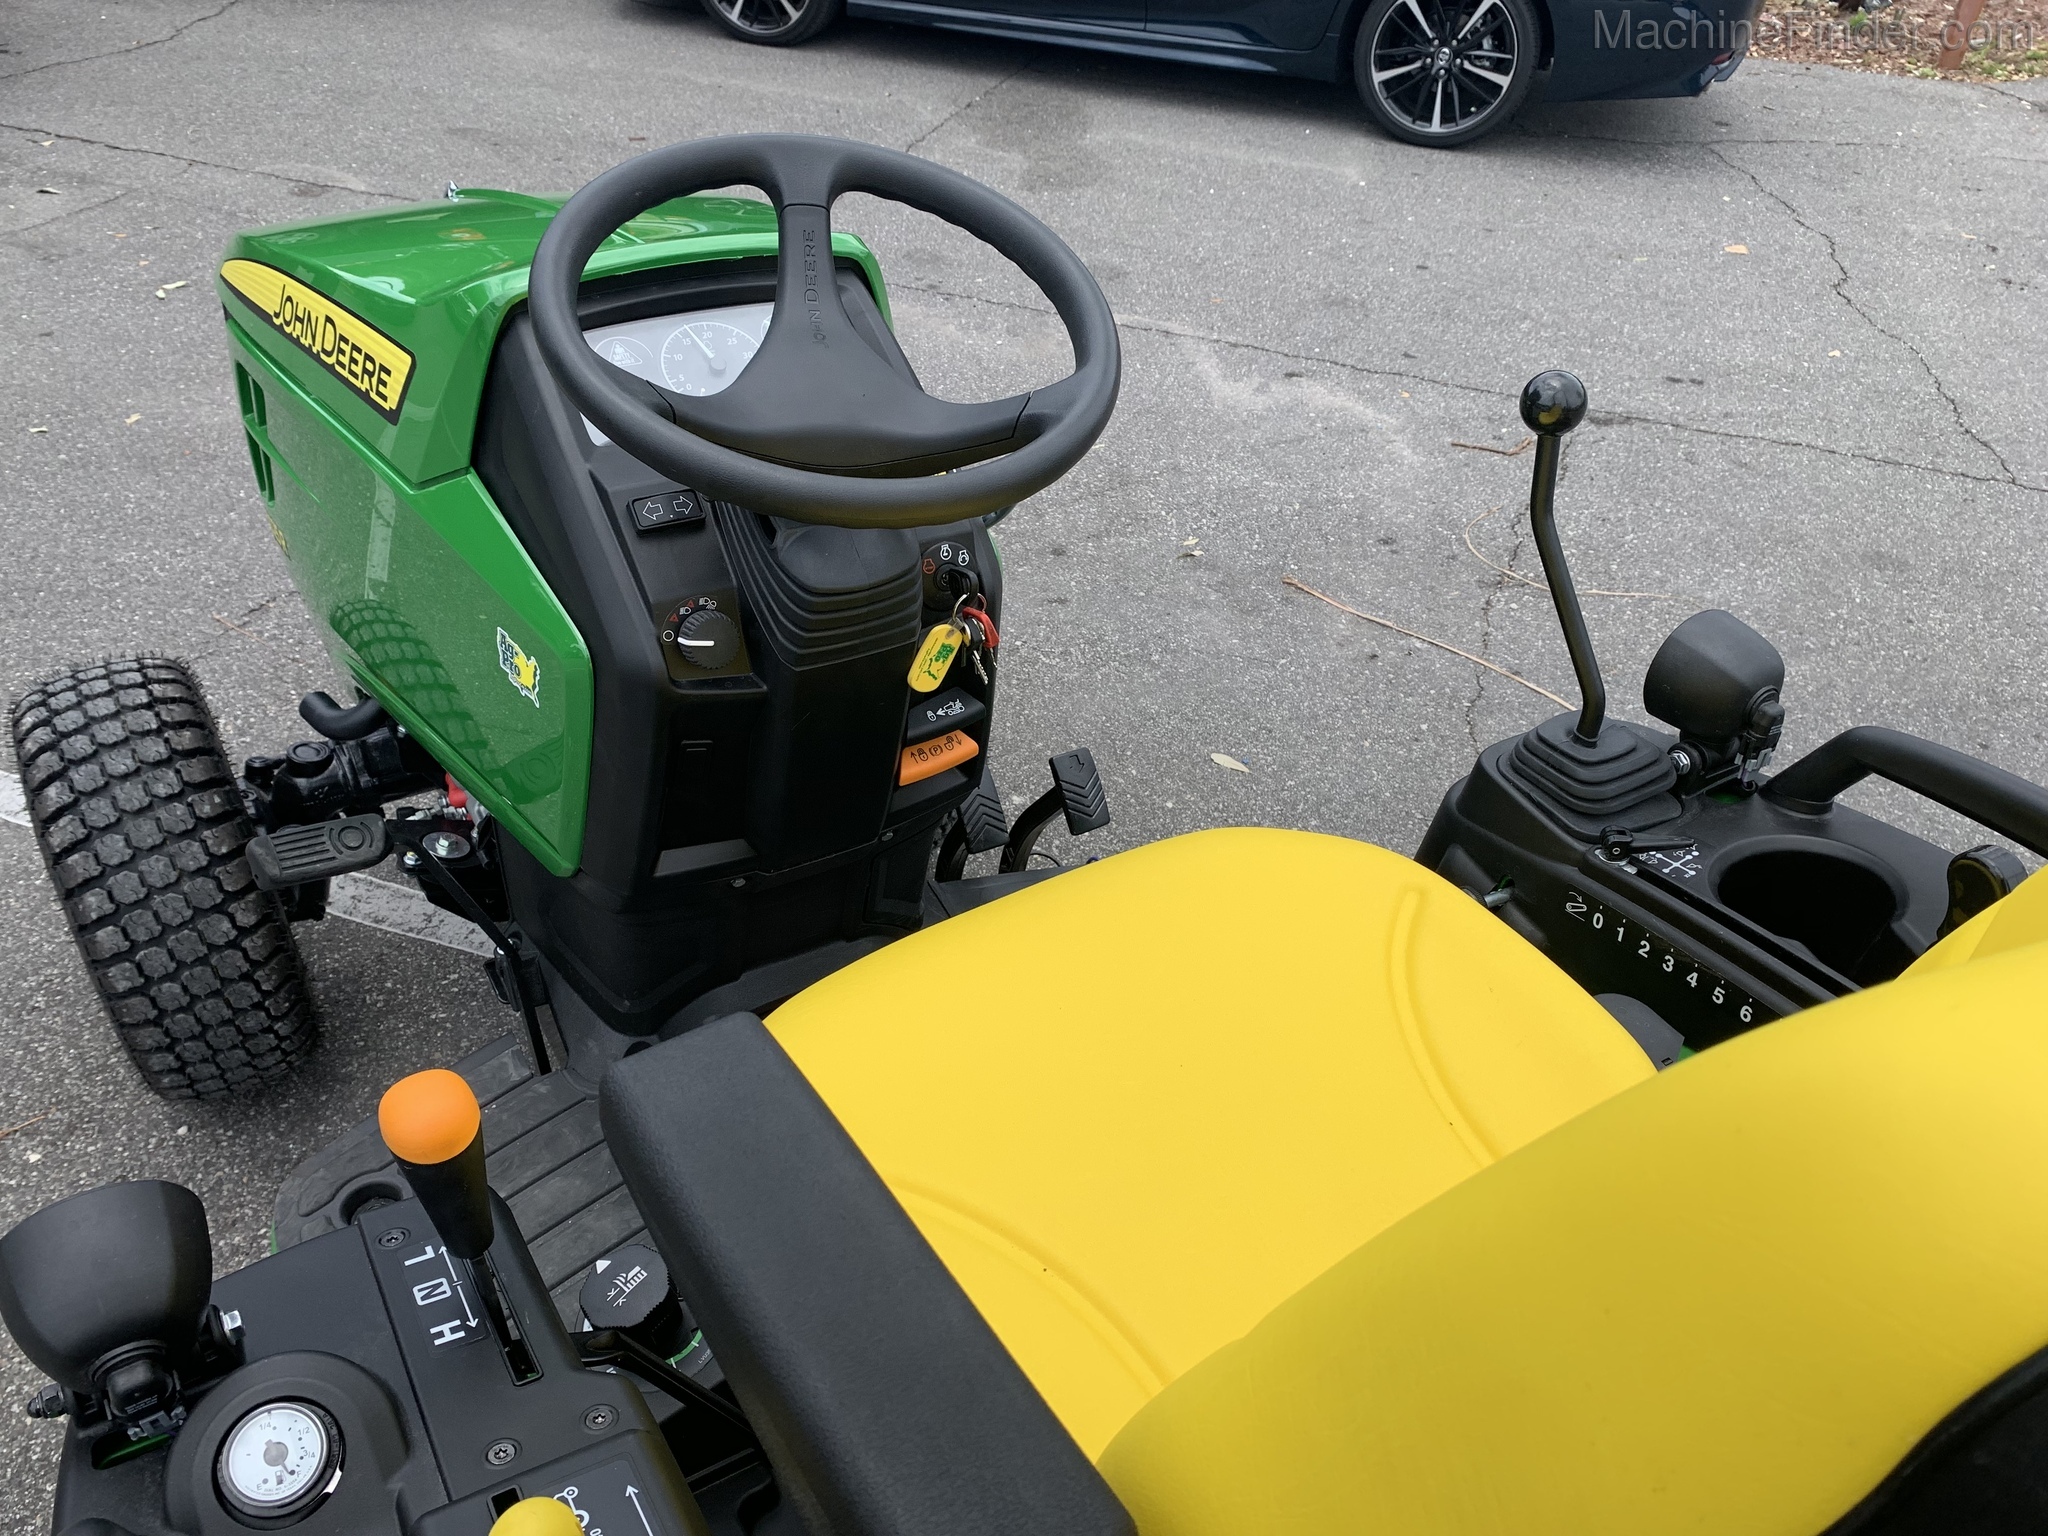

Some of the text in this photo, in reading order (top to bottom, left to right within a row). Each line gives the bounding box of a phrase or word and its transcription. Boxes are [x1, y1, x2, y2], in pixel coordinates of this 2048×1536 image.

[803, 229, 830, 349] JOHN DEERE
[702, 331, 713, 339] 20
[273, 283, 392, 404] JOHN DEERE
[682, 338, 692, 346] 15
[673, 353, 683, 361] 10
[742, 351, 754, 360] 30
[679, 374, 685, 382] 5
[686, 383, 692, 391] 0
[501, 650, 521, 678] Pro
[1592, 912, 1753, 1023] 0 1 2 3 4 5 6
[404, 1245, 436, 1266] L
[417, 1281, 448, 1302] N
[429, 1319, 466, 1346] H
[259, 1422, 272, 1430] 1/4
[297, 1426, 311, 1436] 1/2
[303, 1449, 316, 1459] 3/4
[296, 1470, 303, 1478] F
[256, 1483, 263, 1491] E
